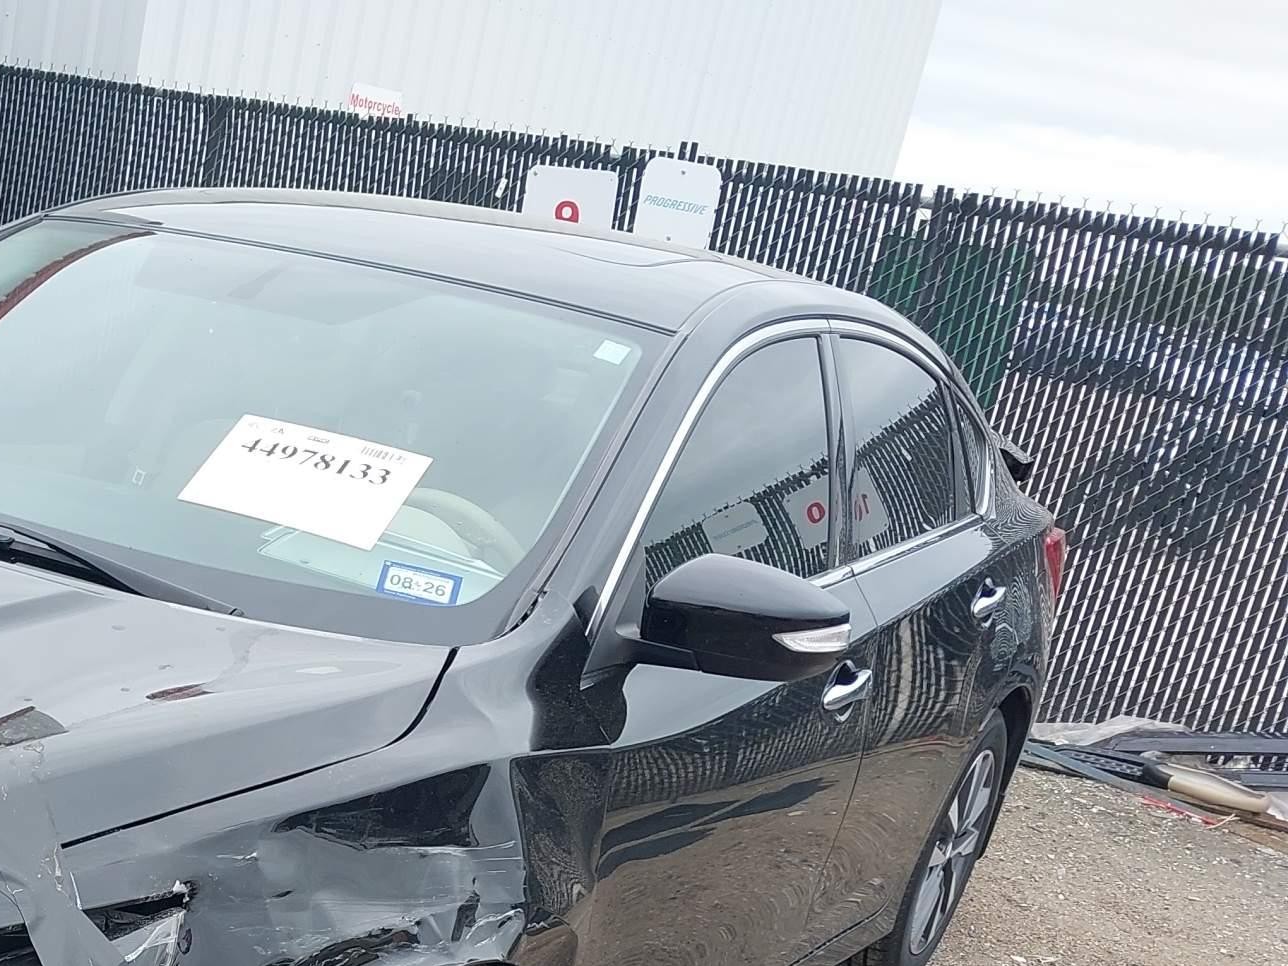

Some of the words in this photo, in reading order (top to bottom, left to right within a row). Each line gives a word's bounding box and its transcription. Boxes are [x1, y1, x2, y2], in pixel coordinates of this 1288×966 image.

[350, 93, 400, 116] Motorcycle
[643, 194, 709, 216] PROGRESSIVE
[240, 438, 392, 486] 44978133
[389, 574, 413, 590] 08
[422, 581, 446, 597] 26
